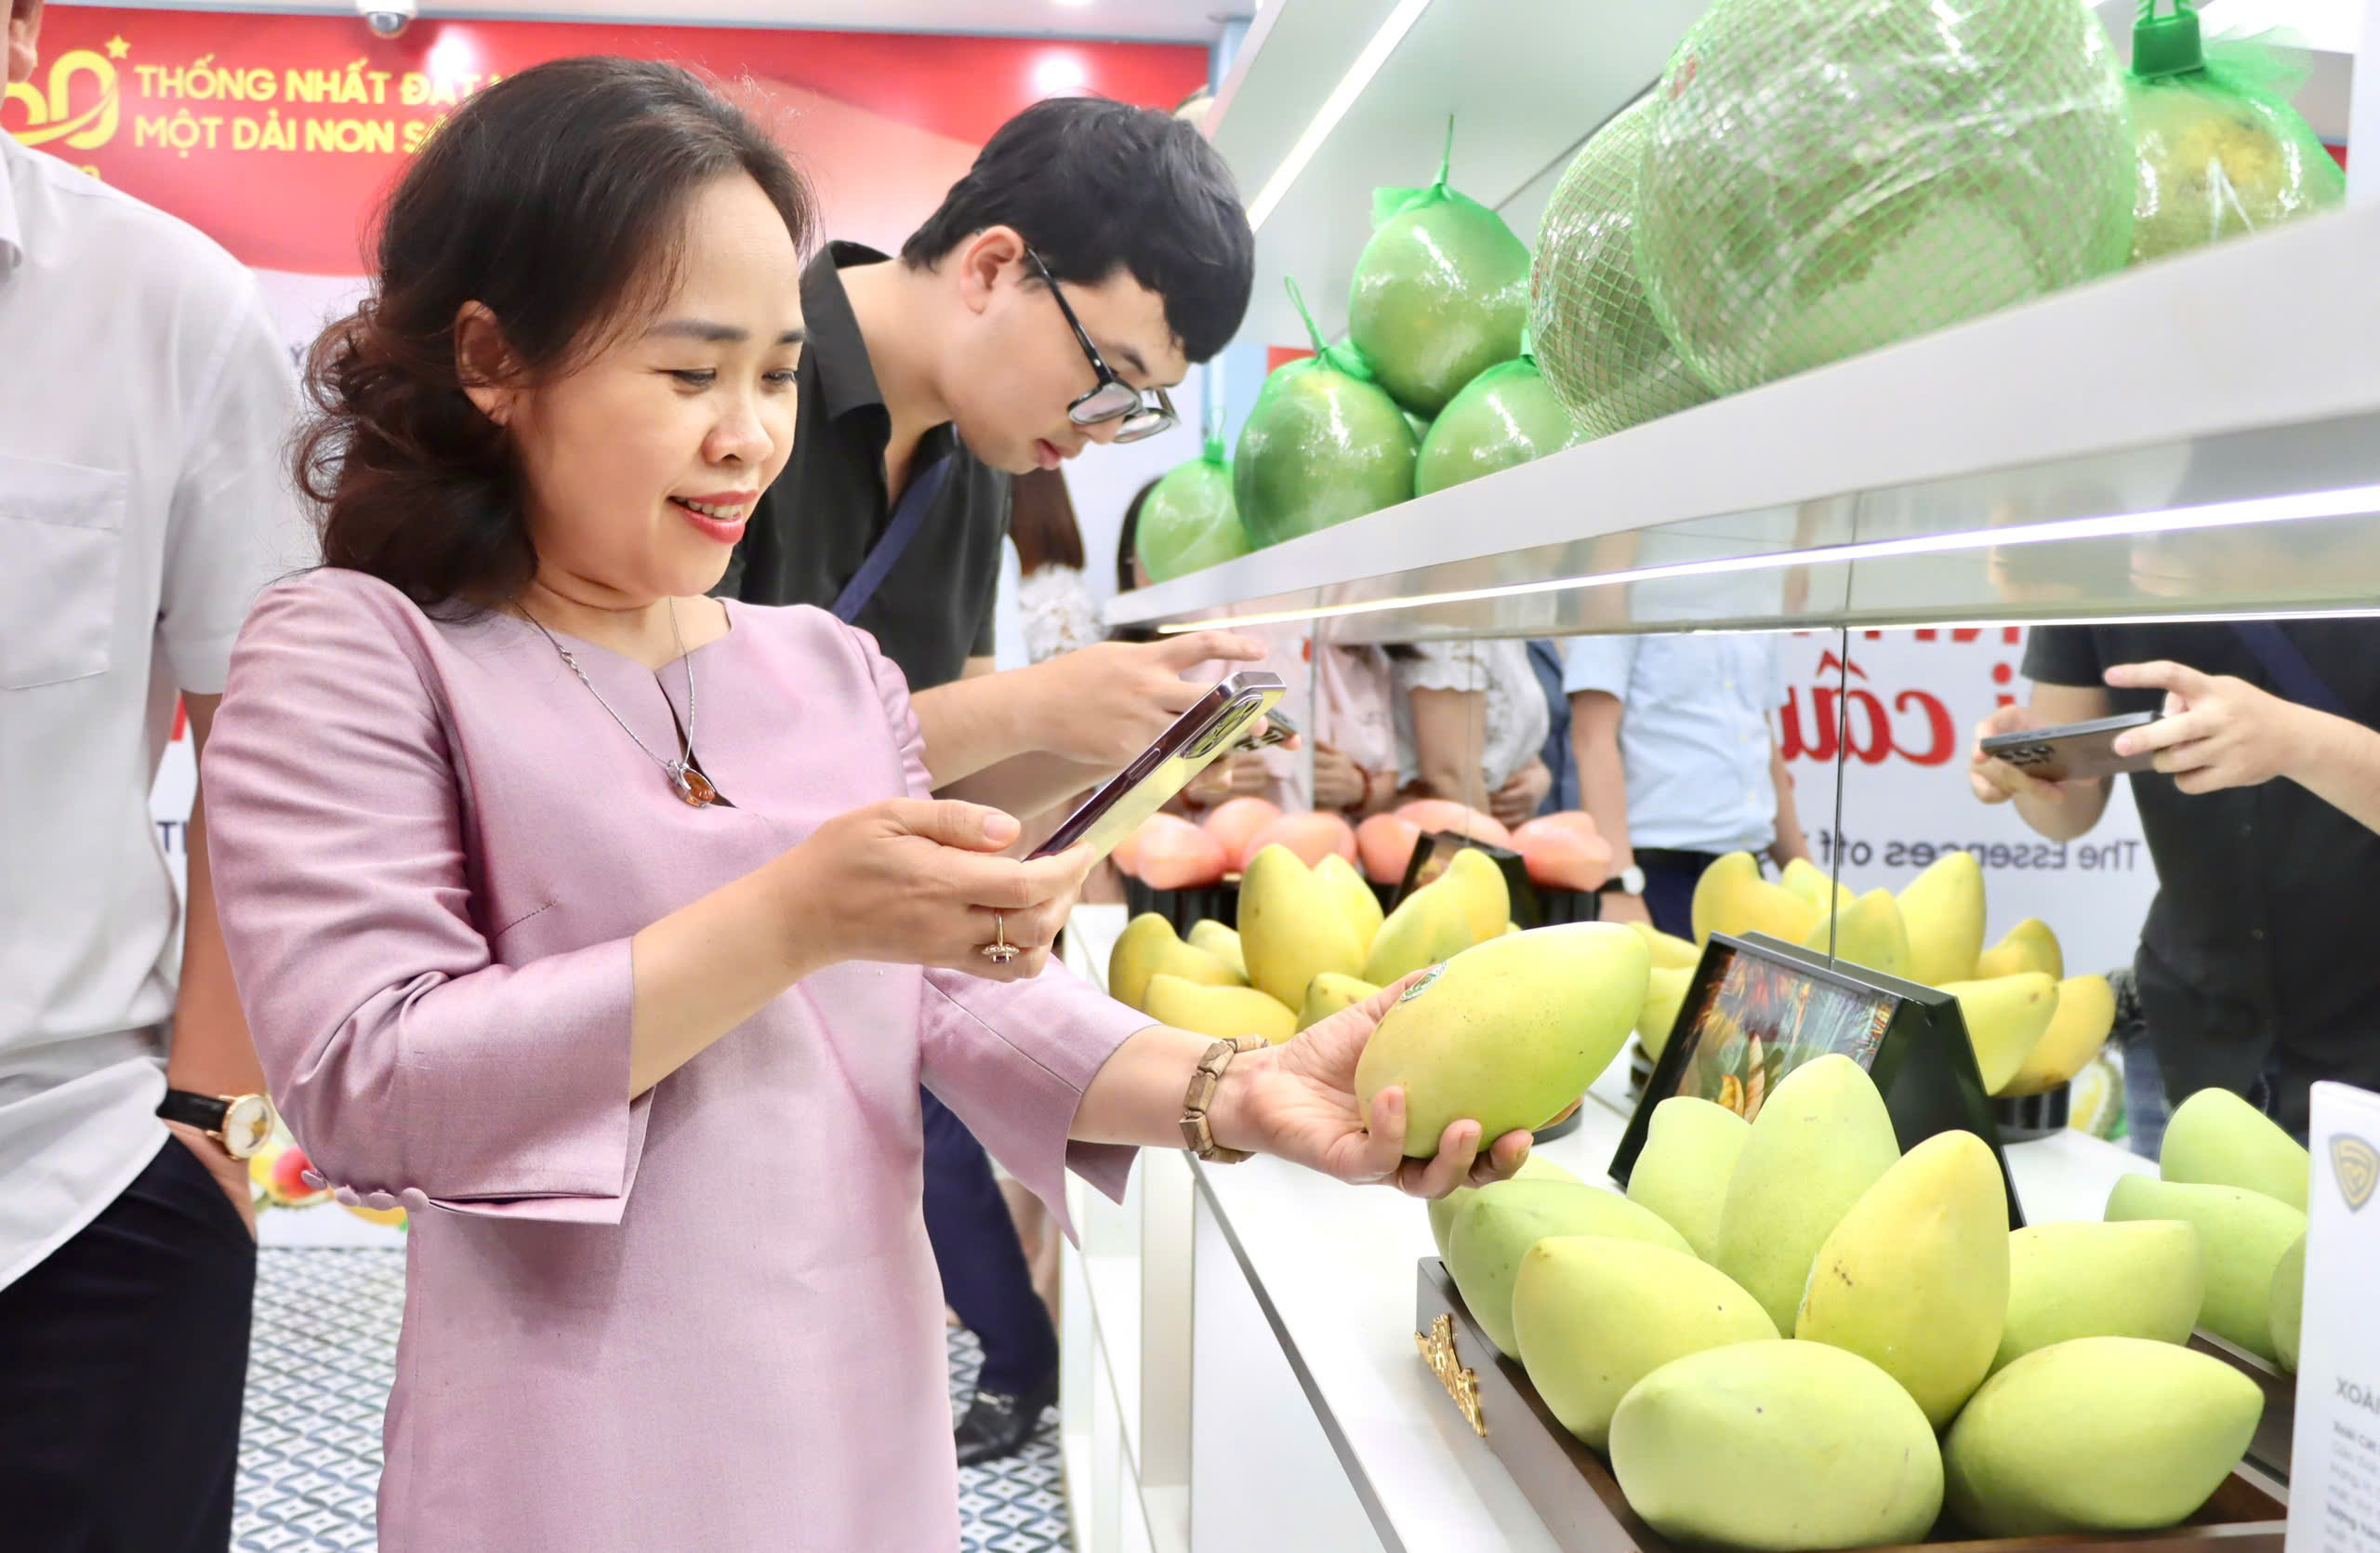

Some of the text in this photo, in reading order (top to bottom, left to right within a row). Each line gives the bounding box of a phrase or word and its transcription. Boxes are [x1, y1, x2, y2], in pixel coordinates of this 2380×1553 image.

[134, 53, 277, 101] THỐNG
[285, 57, 392, 105] NHẤT
[134, 107, 224, 159] MỘT
[232, 107, 297, 152] DẢI
[305, 118, 395, 153] NON
